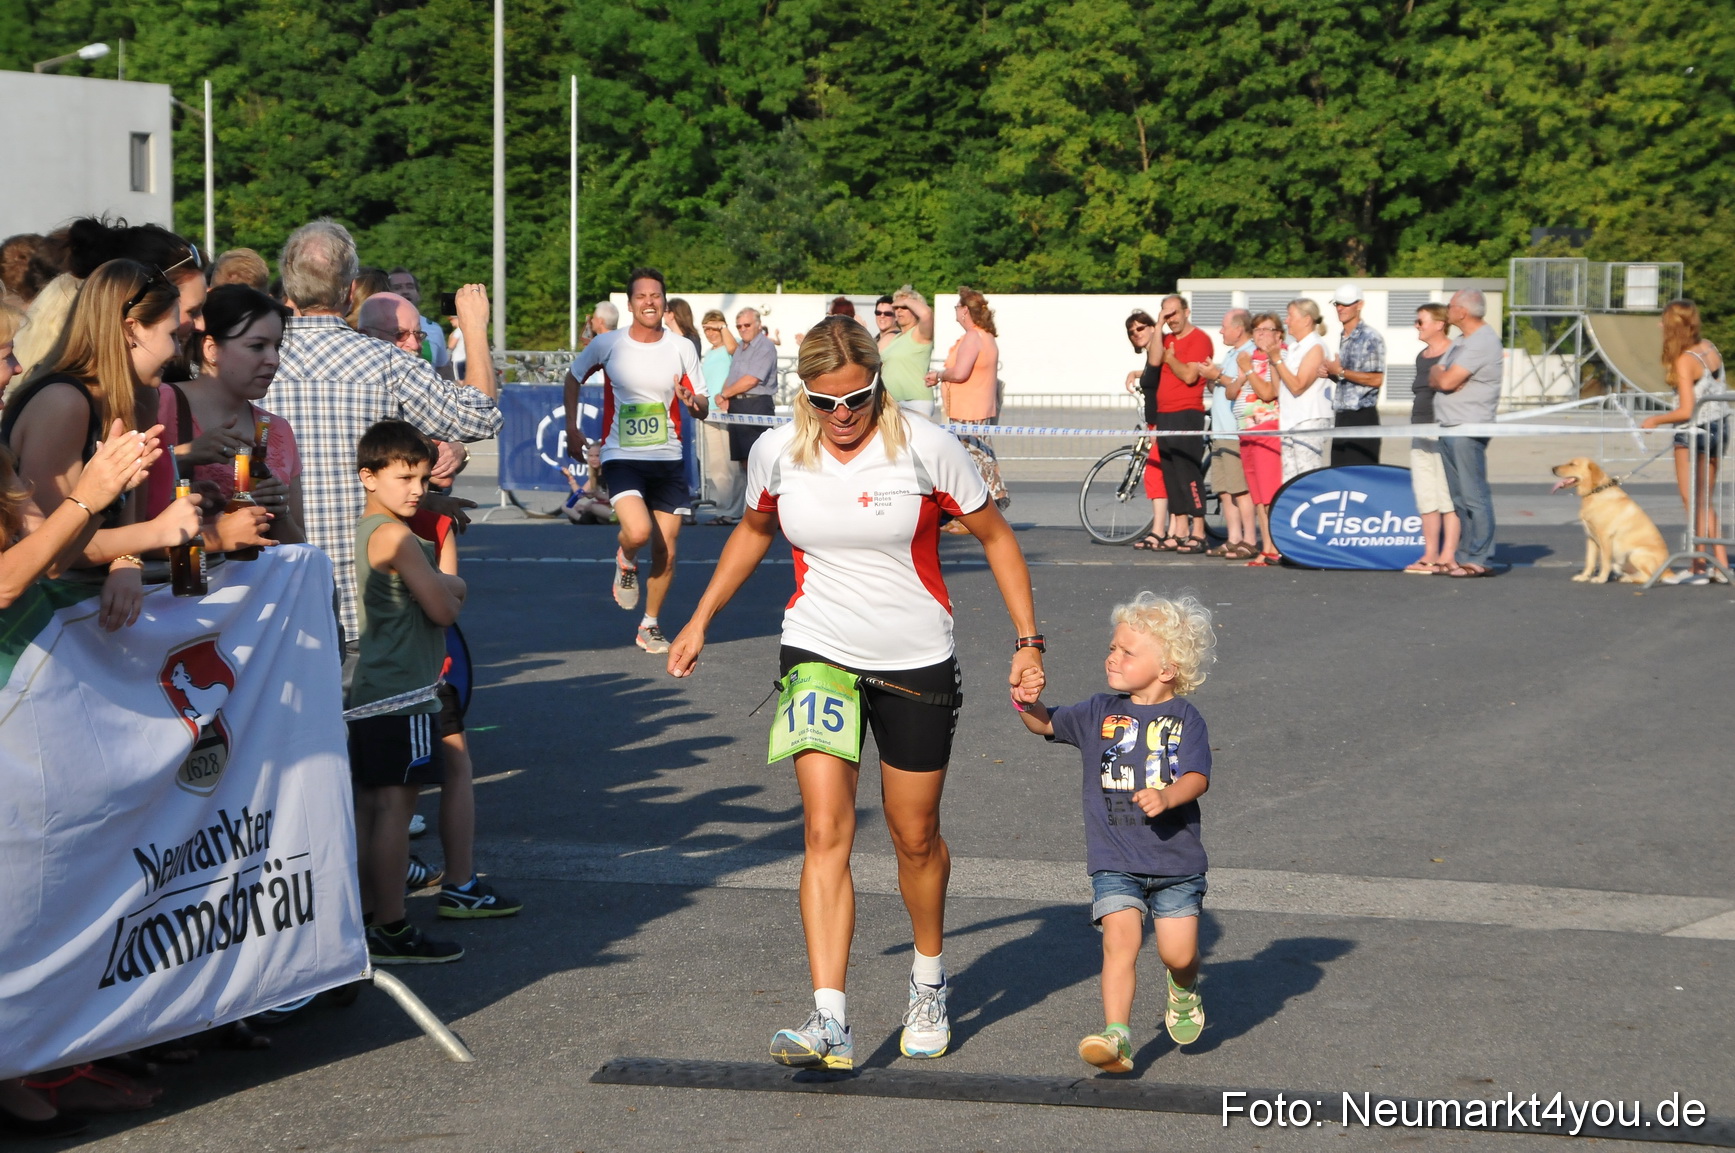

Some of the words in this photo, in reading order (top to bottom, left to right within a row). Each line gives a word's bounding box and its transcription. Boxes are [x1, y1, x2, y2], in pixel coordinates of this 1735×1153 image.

[625, 417, 660, 436] 309
[1315, 509, 1422, 535] Fische
[1327, 535, 1427, 547] AUTOMOBILE
[782, 691, 845, 733] 115
[805, 727, 823, 736] Schön
[185, 752, 220, 783] 1628
[132, 805, 273, 898] Neumarkter
[96, 858, 315, 990] Lammsbräu
